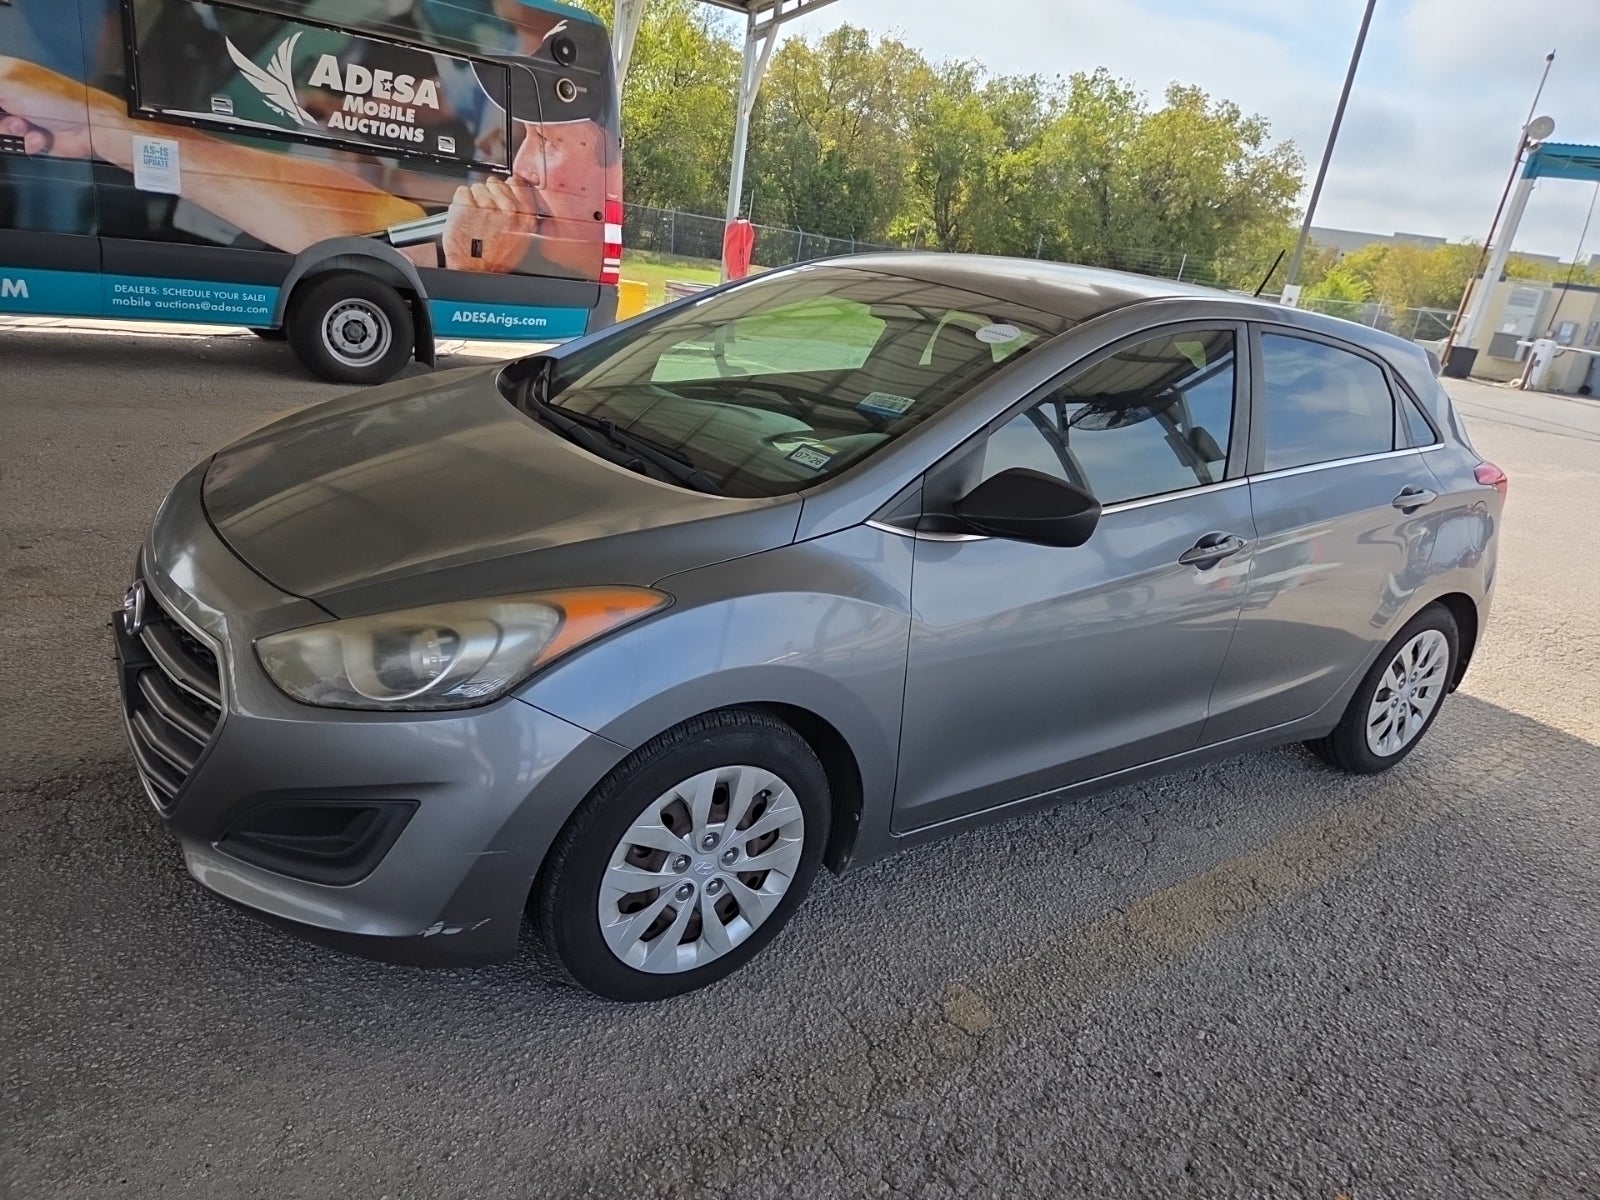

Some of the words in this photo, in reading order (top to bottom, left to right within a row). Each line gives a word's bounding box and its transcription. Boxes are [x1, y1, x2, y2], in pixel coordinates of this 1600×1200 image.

[308, 53, 440, 110] ADESA
[342, 94, 416, 123] MOBILE
[327, 111, 425, 143] AUCTIONS
[143, 144, 169, 157] AS-IS
[143, 157, 169, 168] UPDATE
[114, 284, 159, 295] DEALERS:
[162, 287, 211, 299] SCHEDULE
[213, 291, 239, 300] YOUR
[242, 293, 266, 302] SALE!
[112, 296, 151, 307] mobile
[155, 300, 268, 314] auctions@adesa.com
[451, 310, 547, 328] ADESArigs.com
